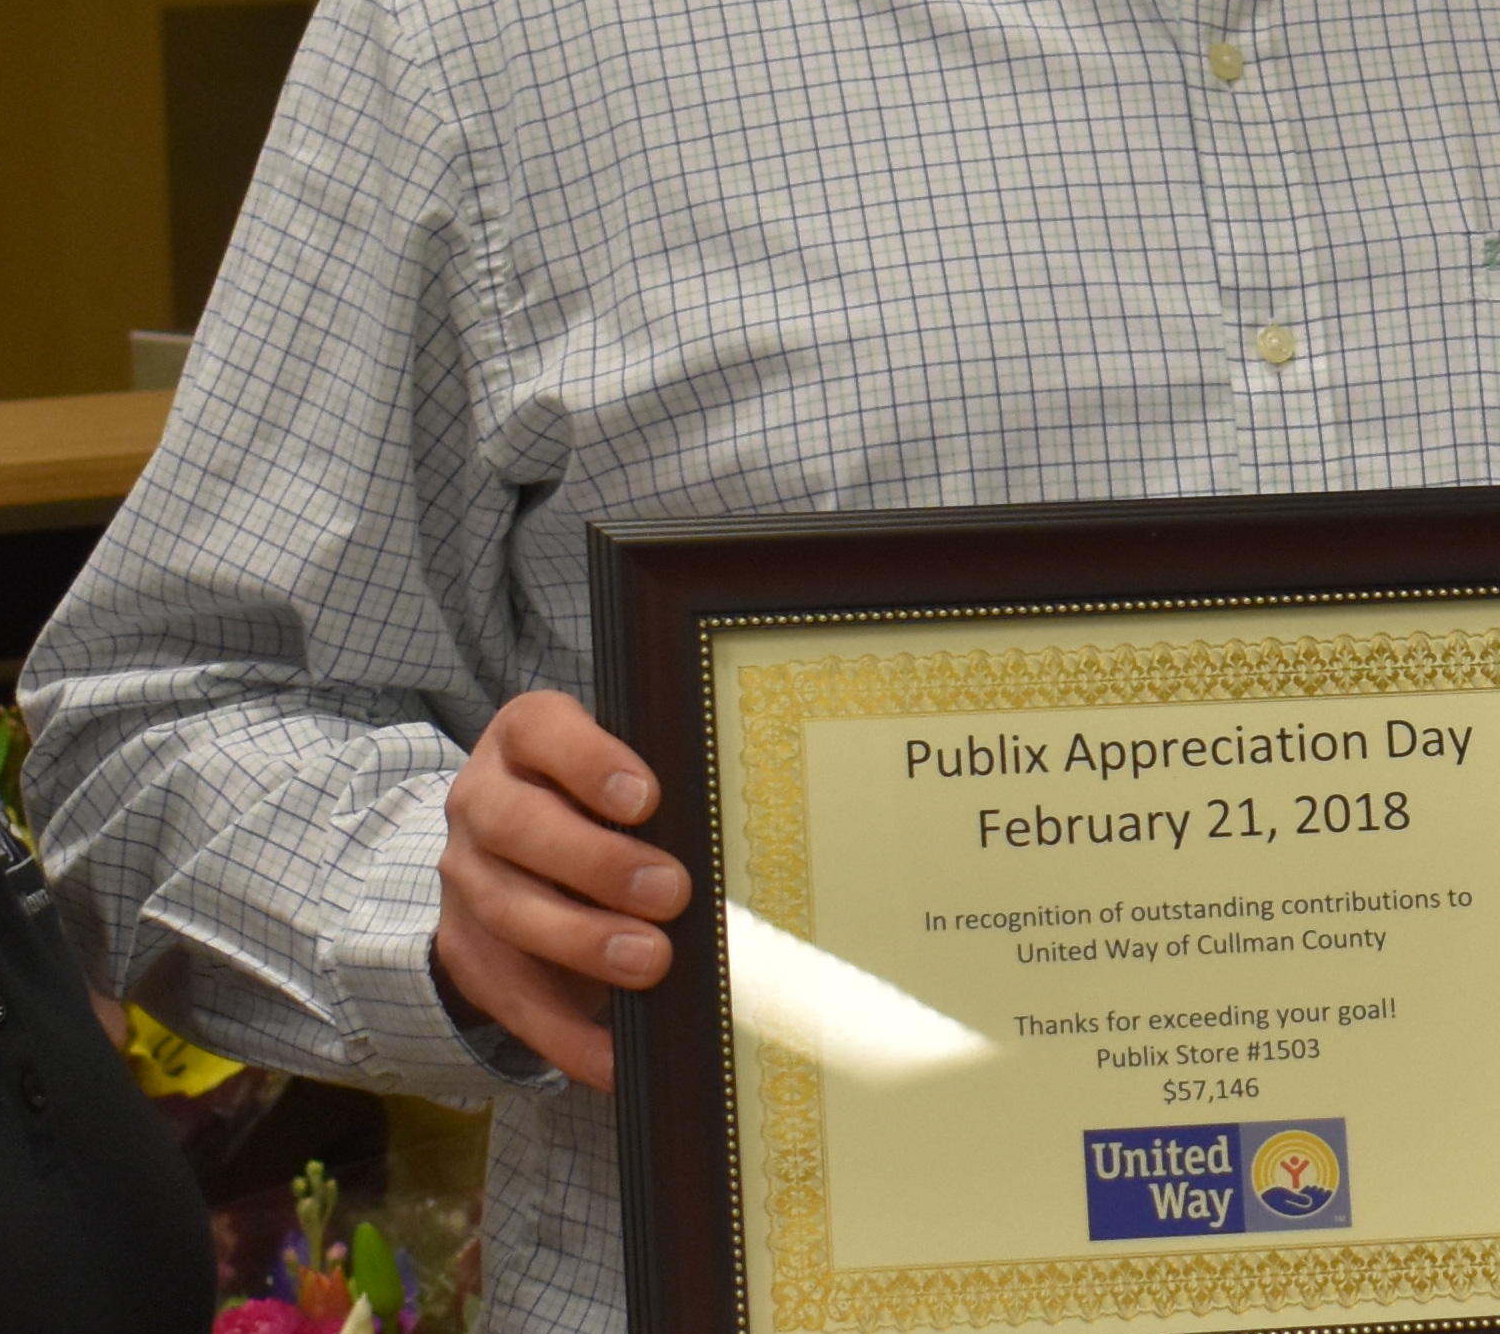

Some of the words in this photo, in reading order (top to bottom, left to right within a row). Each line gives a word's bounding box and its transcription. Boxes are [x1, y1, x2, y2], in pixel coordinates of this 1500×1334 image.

[907, 734, 1048, 778] Publix
[1064, 723, 1367, 780] Appreciation
[1387, 720, 1472, 765] Day
[980, 805, 1190, 850] February
[1208, 798, 1276, 843] 21,
[1295, 792, 1410, 834] 2018
[926, 912, 946, 931] In
[956, 905, 1091, 932] recognition
[1100, 901, 1123, 923] of
[1131, 896, 1274, 922] outstanding
[1282, 890, 1440, 914] contributions
[1447, 889, 1472, 907] to
[1018, 942, 1094, 963] United
[1106, 939, 1159, 962] Way
[1166, 934, 1190, 956] of
[1198, 932, 1294, 955] Cullman
[1302, 929, 1386, 951] County
[1014, 1012, 1099, 1036] Thanks
[1106, 1011, 1141, 1032] for
[1149, 1005, 1269, 1030] exceeding
[1276, 1006, 1330, 1029] your
[1338, 998, 1395, 1026] goal!
[1098, 1045, 1168, 1069] Publix
[1176, 1045, 1239, 1065] Store
[1247, 1038, 1320, 1061] #1503
[1163, 1078, 1259, 1105] $57,146
[1092, 1135, 1233, 1179] United
[1150, 1182, 1233, 1228] Way
